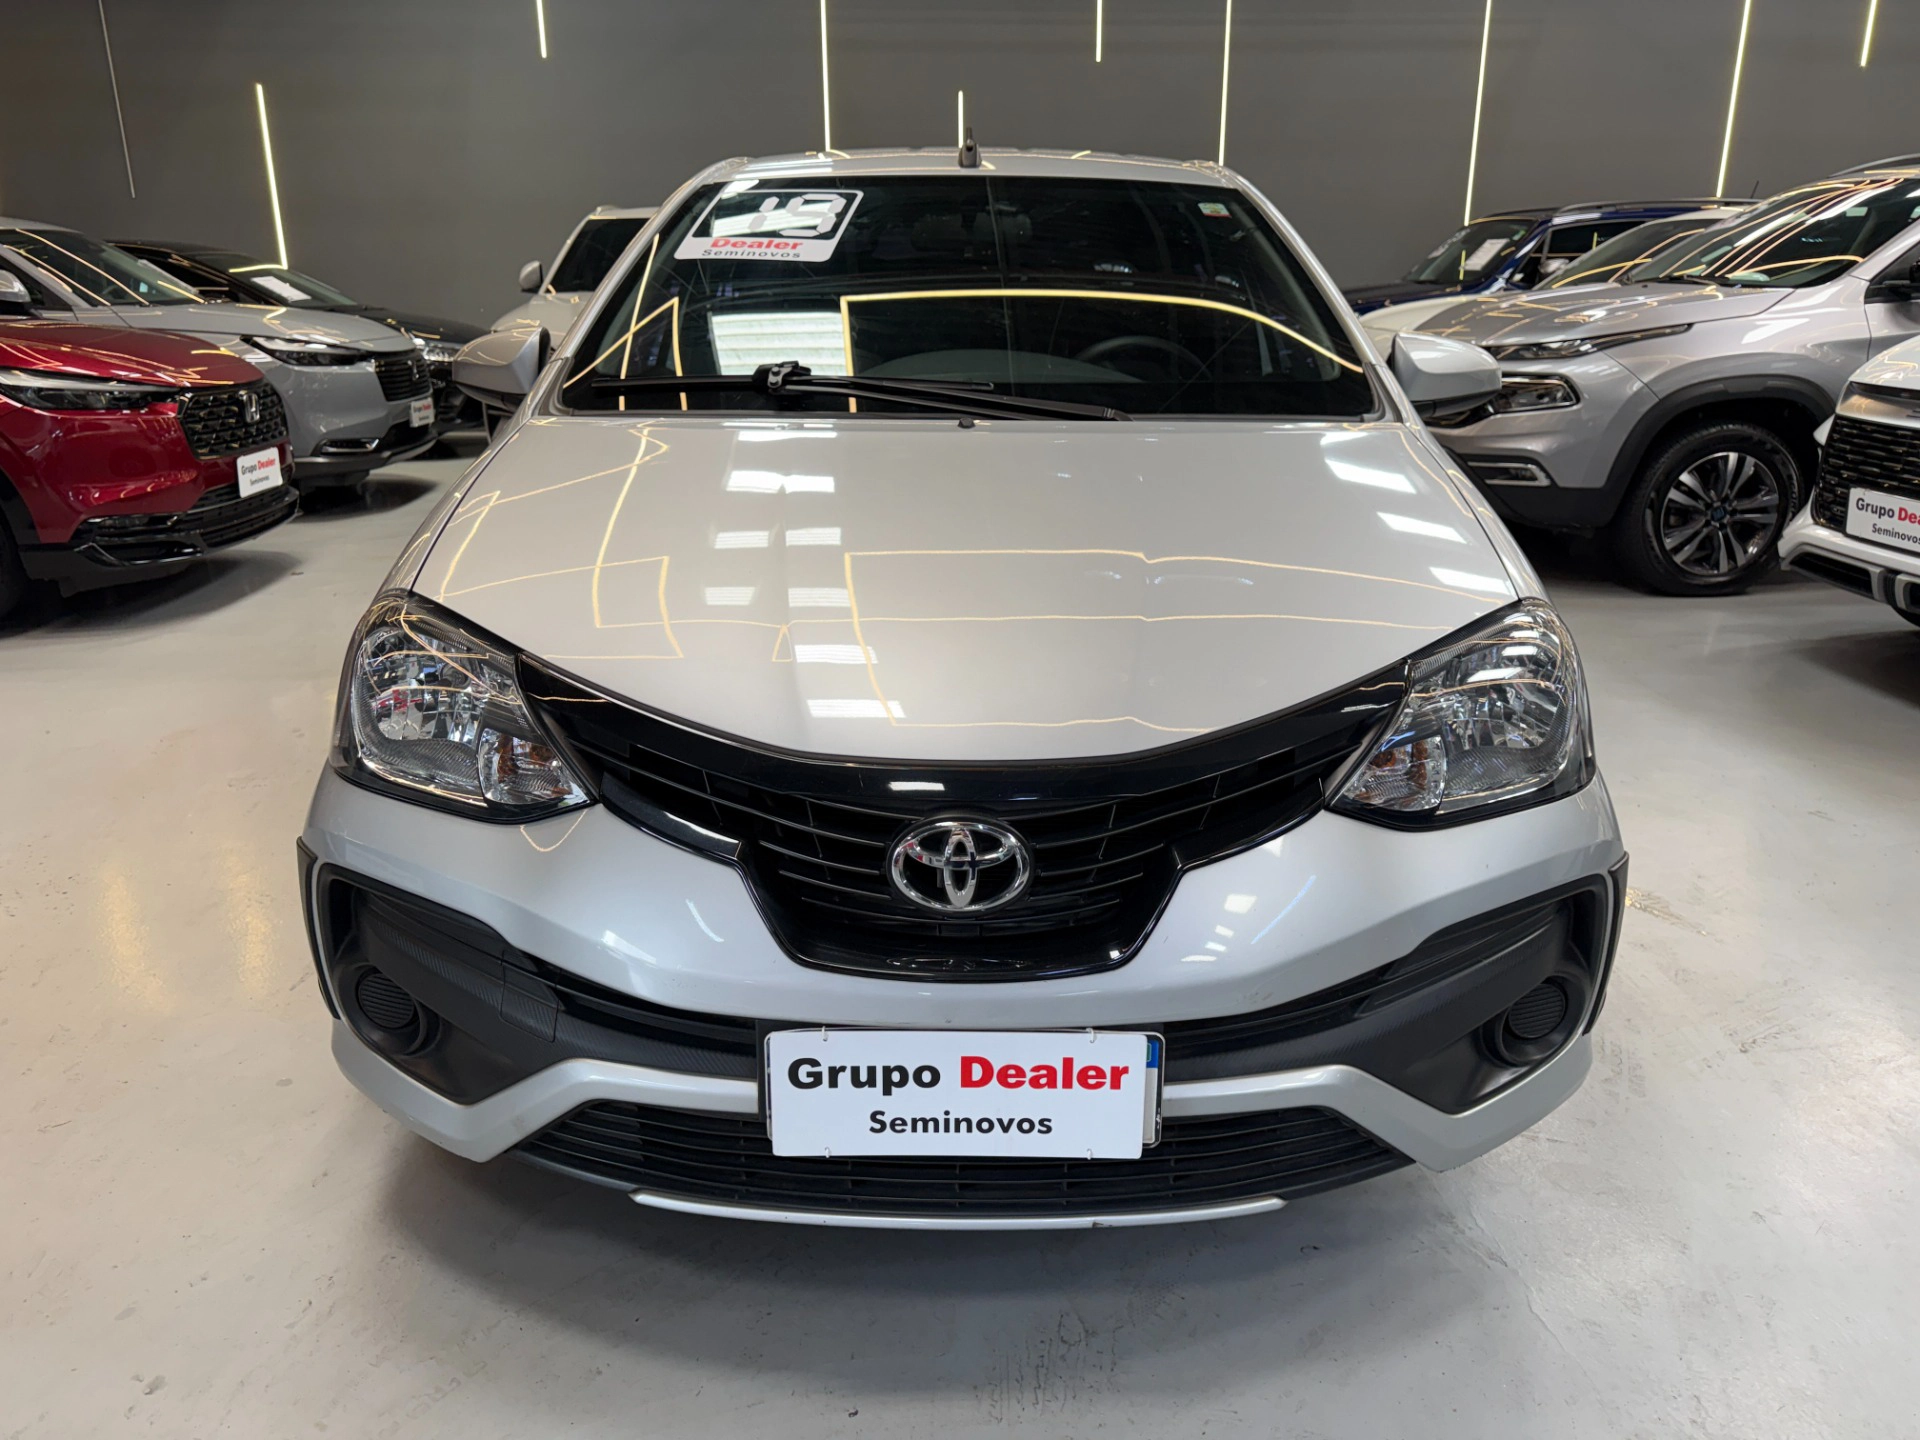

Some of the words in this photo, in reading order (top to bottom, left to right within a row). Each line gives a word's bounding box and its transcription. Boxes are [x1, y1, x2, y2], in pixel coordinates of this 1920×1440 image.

[747, 193, 848, 238] 19
[701, 249, 801, 259] Seminovos
[710, 237, 804, 250] Dealer
[1855, 497, 1895, 519] Grupo
[787, 1057, 941, 1096] Grupo
[960, 1055, 1130, 1090] Dealer
[868, 1110, 1053, 1135] Seminovos
